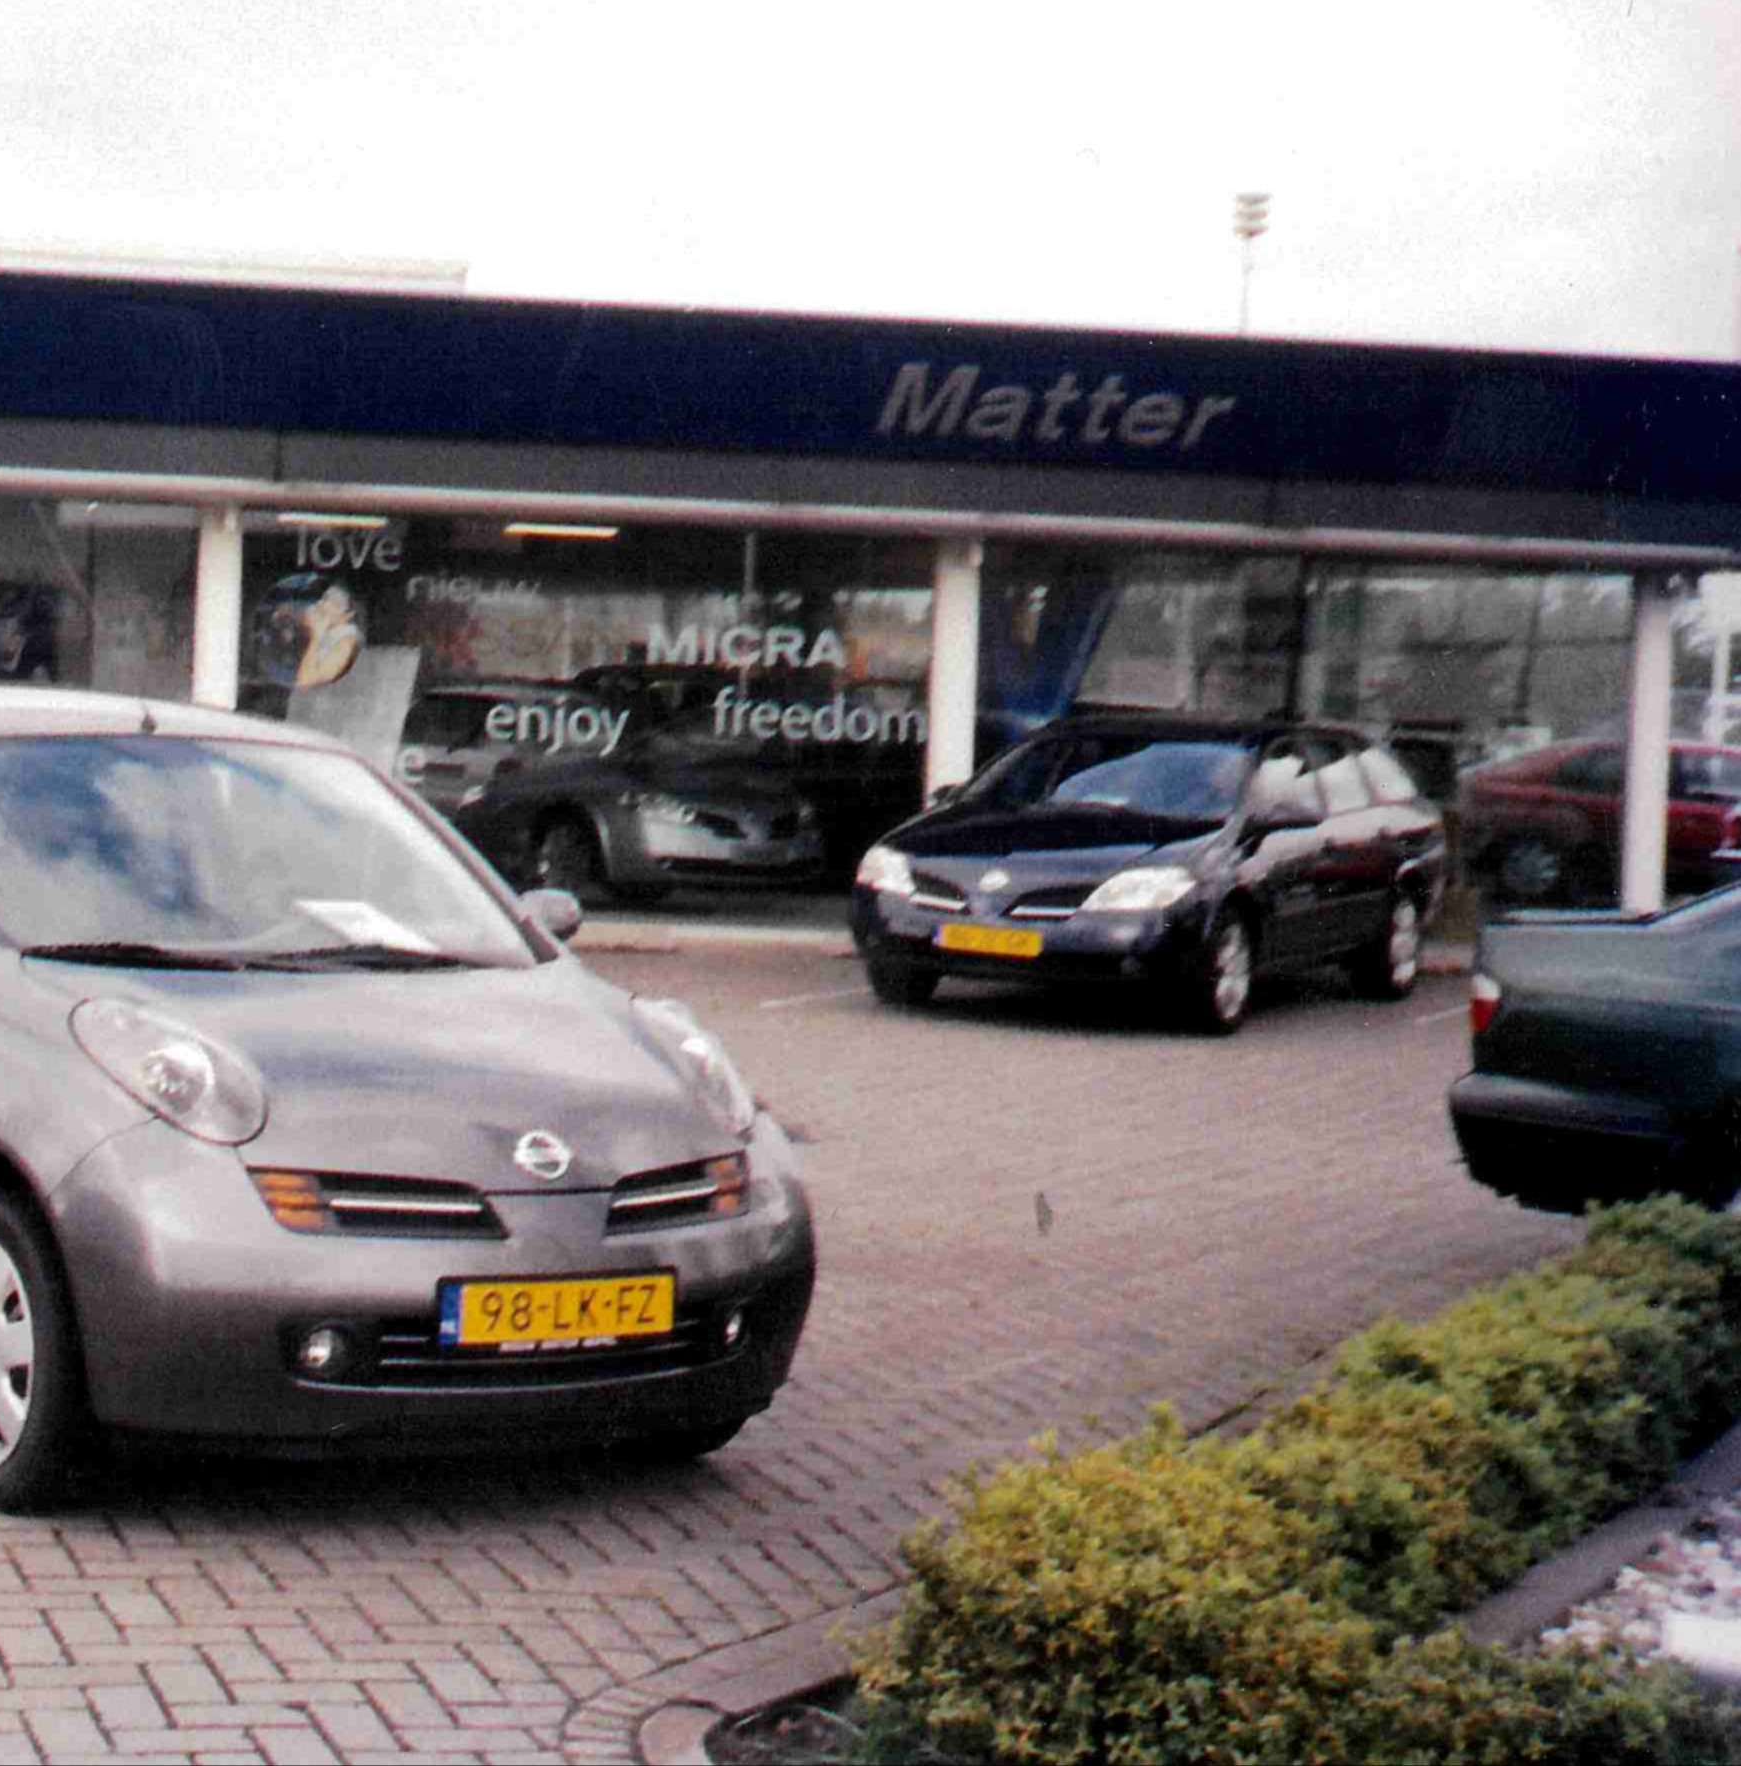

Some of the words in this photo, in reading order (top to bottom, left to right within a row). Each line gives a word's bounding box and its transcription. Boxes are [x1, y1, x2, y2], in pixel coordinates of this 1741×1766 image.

[874, 360, 1238, 450] Matter
[294, 522, 403, 571] love
[644, 623, 846, 668] MICRA
[485, 696, 630, 758] enjoy
[712, 685, 931, 743] freedom
[481, 1284, 657, 1332] 98-LK-FZ
